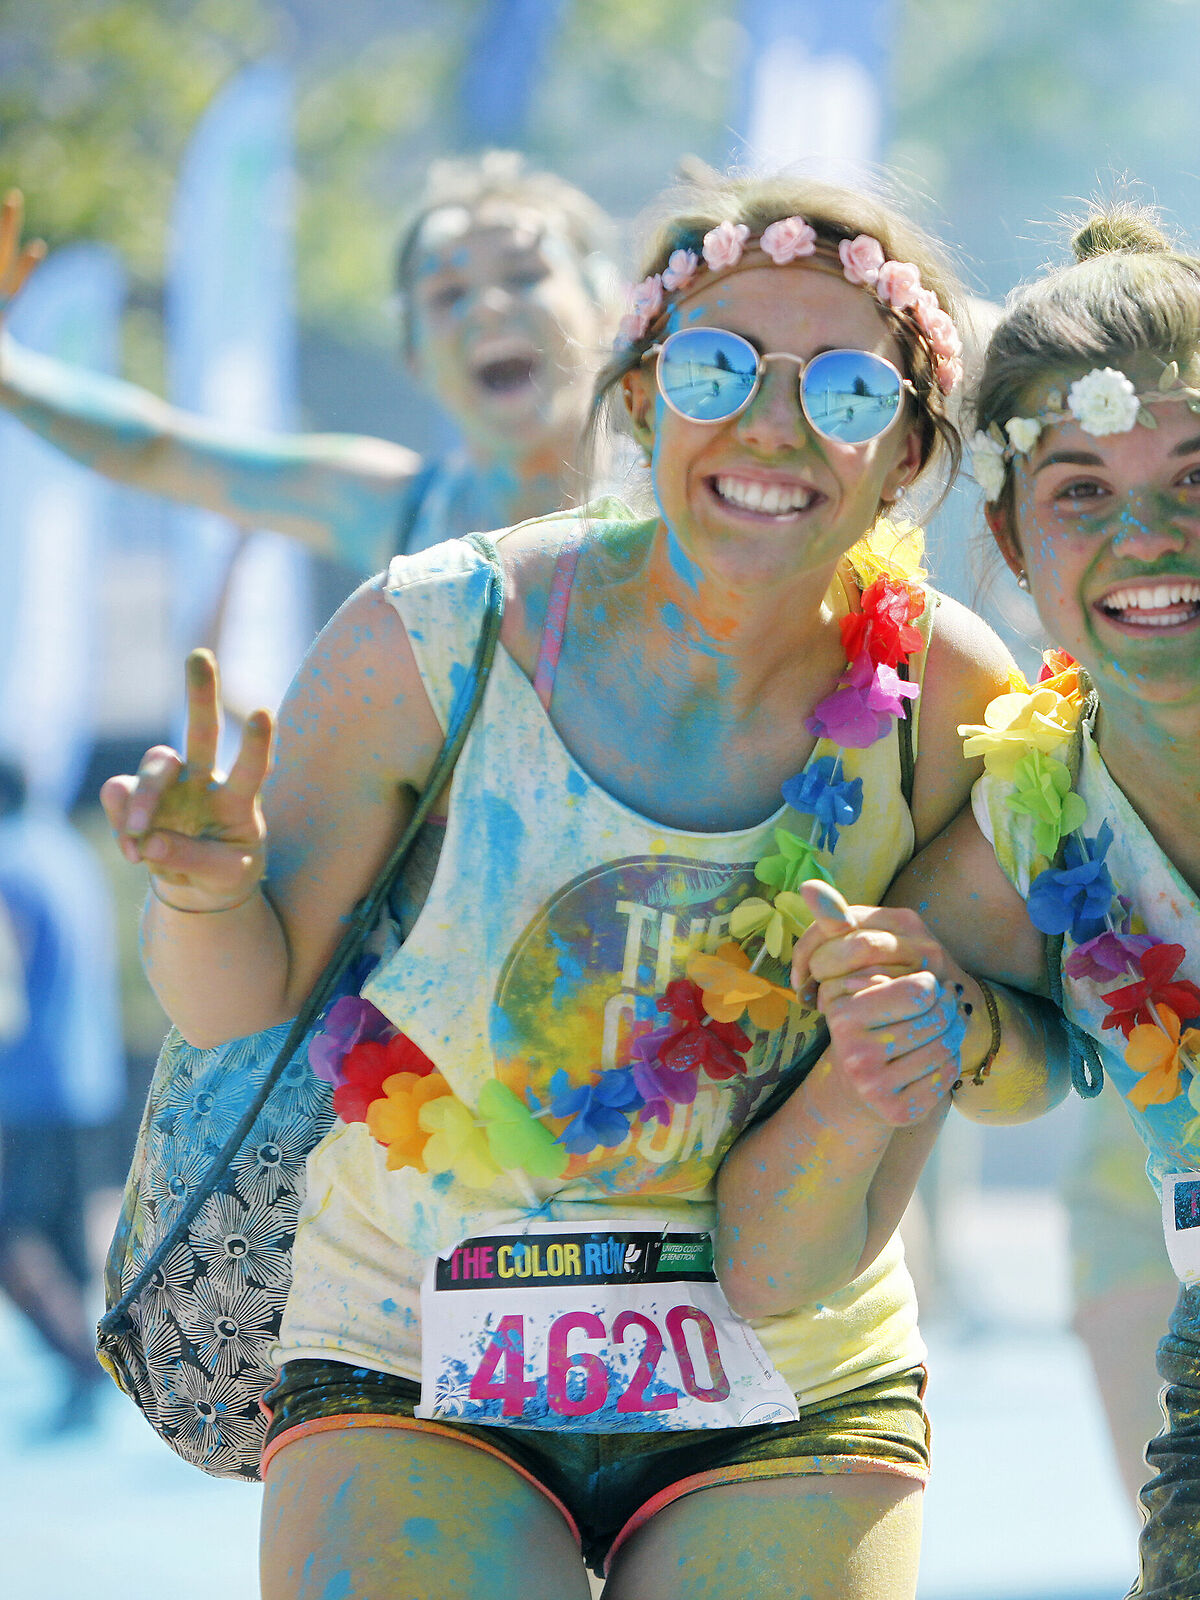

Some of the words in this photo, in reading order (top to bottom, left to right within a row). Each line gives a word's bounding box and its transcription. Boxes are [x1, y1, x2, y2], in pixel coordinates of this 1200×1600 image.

[449, 1246, 494, 1281] THE
[498, 1243, 582, 1279] COLOR
[585, 1242, 626, 1275] RUN
[662, 1244, 683, 1253] UNITED
[683, 1244, 704, 1253] COLORS
[469, 1304, 732, 1418] 4620
